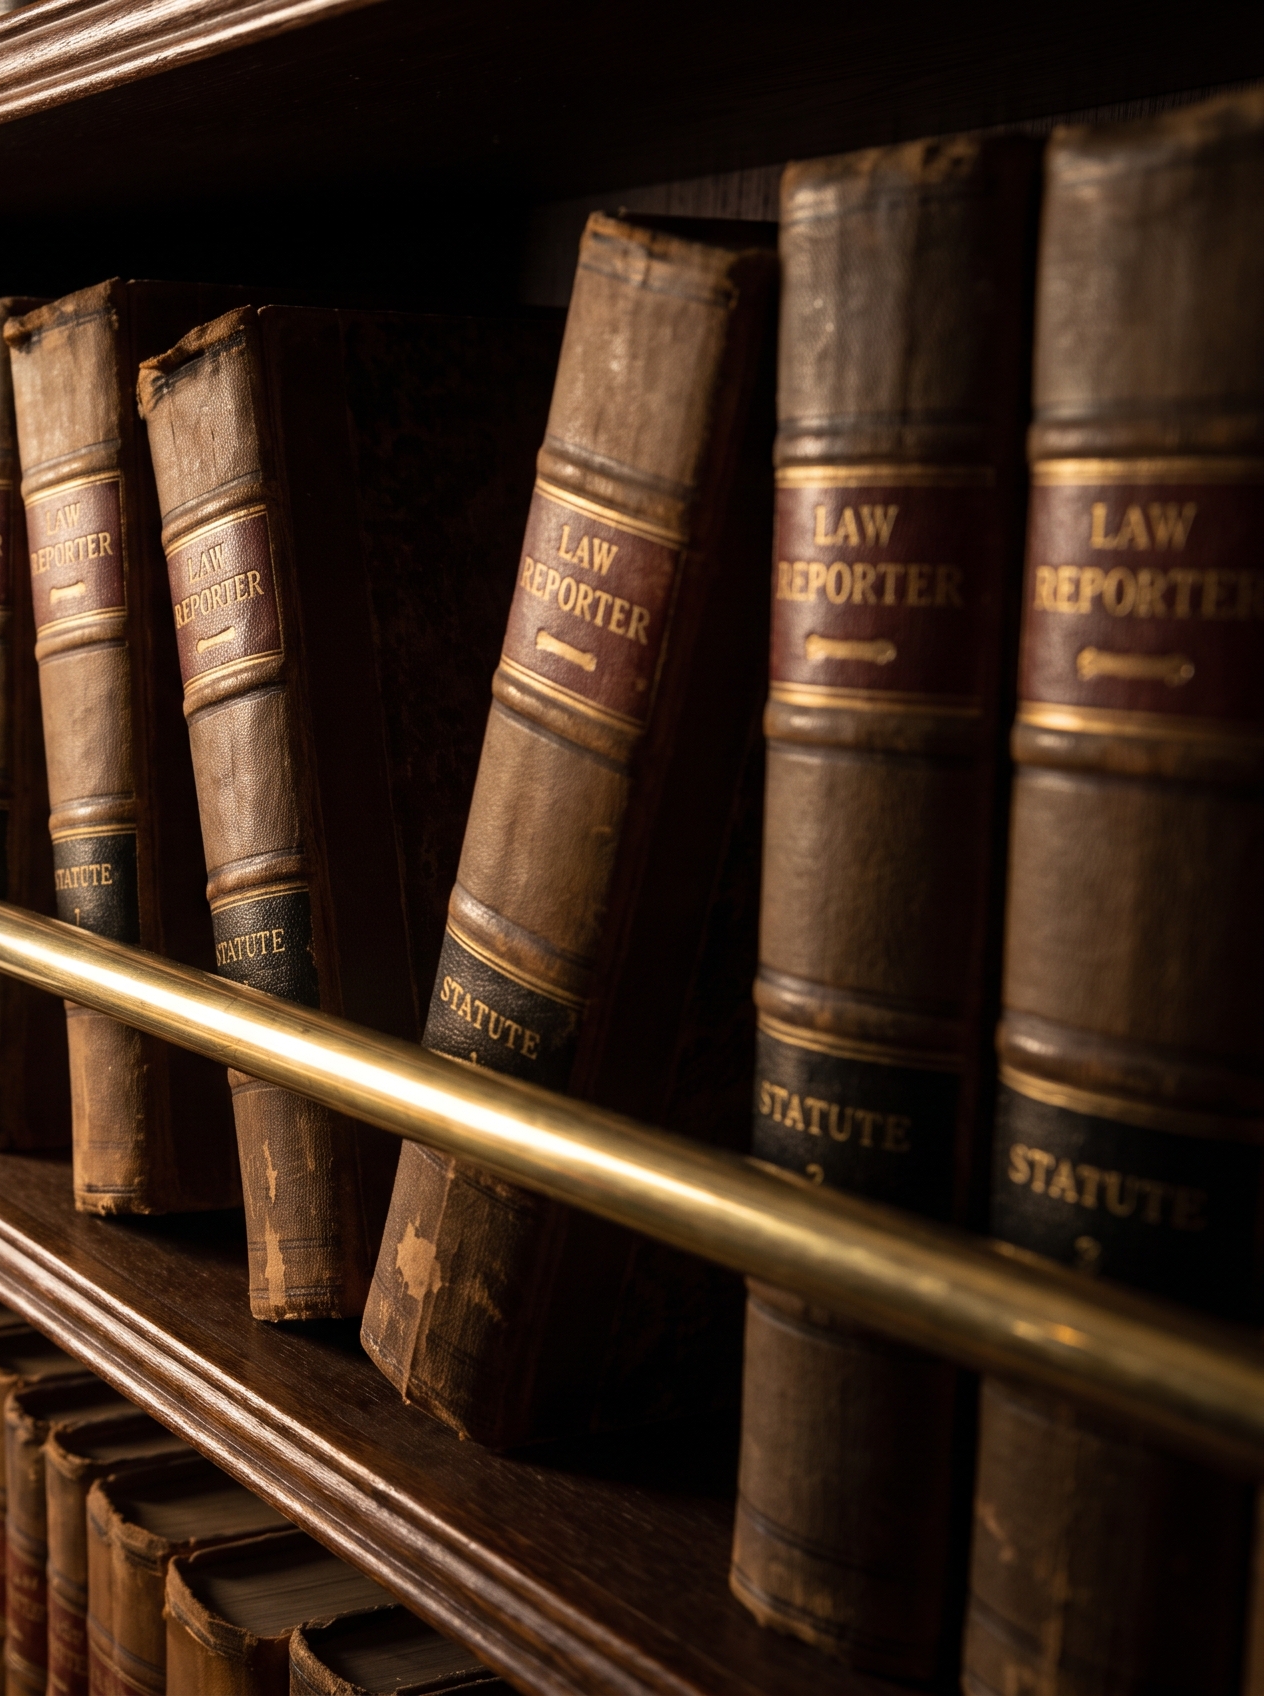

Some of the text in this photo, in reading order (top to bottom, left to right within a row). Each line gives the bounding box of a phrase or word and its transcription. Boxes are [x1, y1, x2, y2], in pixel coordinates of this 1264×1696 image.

[46, 502, 81, 536] LAW
[814, 504, 899, 547] LAW
[1091, 502, 1197, 550] LAW
[31, 532, 113, 575] REPORTER
[188, 542, 224, 583] LAW
[558, 525, 619, 577] LAW
[175, 570, 264, 628] REPORTER
[519, 556, 649, 645] REPORTER
[777, 561, 964, 608] REPORTER
[216, 928, 286, 967] STATUTE
[440, 975, 541, 1061] STATUTE
[759, 1081, 913, 1154] STATUTE
[1008, 1143, 1209, 1233] STATUTE
